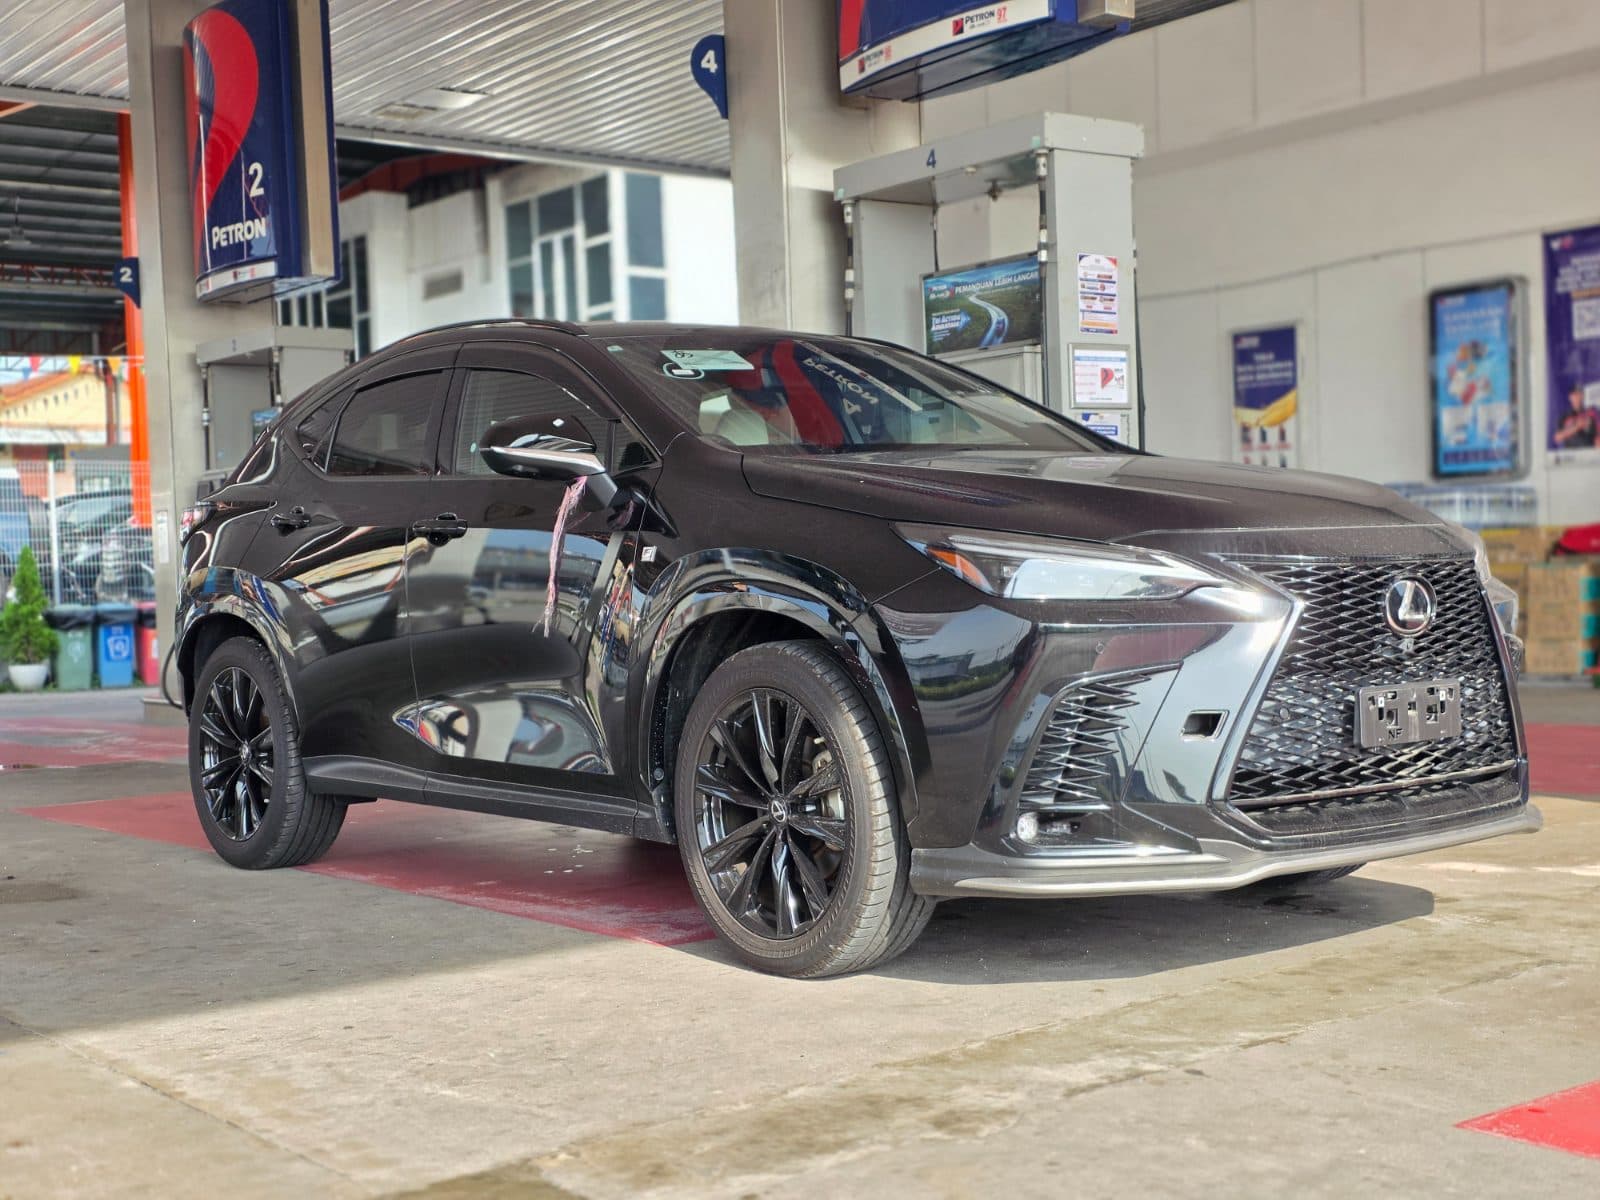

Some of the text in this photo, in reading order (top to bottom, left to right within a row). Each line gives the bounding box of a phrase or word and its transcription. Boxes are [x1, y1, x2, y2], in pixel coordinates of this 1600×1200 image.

[964, 10, 995, 25] PETRON
[997, 7, 1008, 19] 97
[701, 49, 718, 73] 4
[926, 148, 937, 169] 4
[248, 162, 265, 198] 2
[211, 216, 267, 250] PETRON
[119, 266, 133, 282] 2
[954, 281, 994, 294] PEMANDUAN
